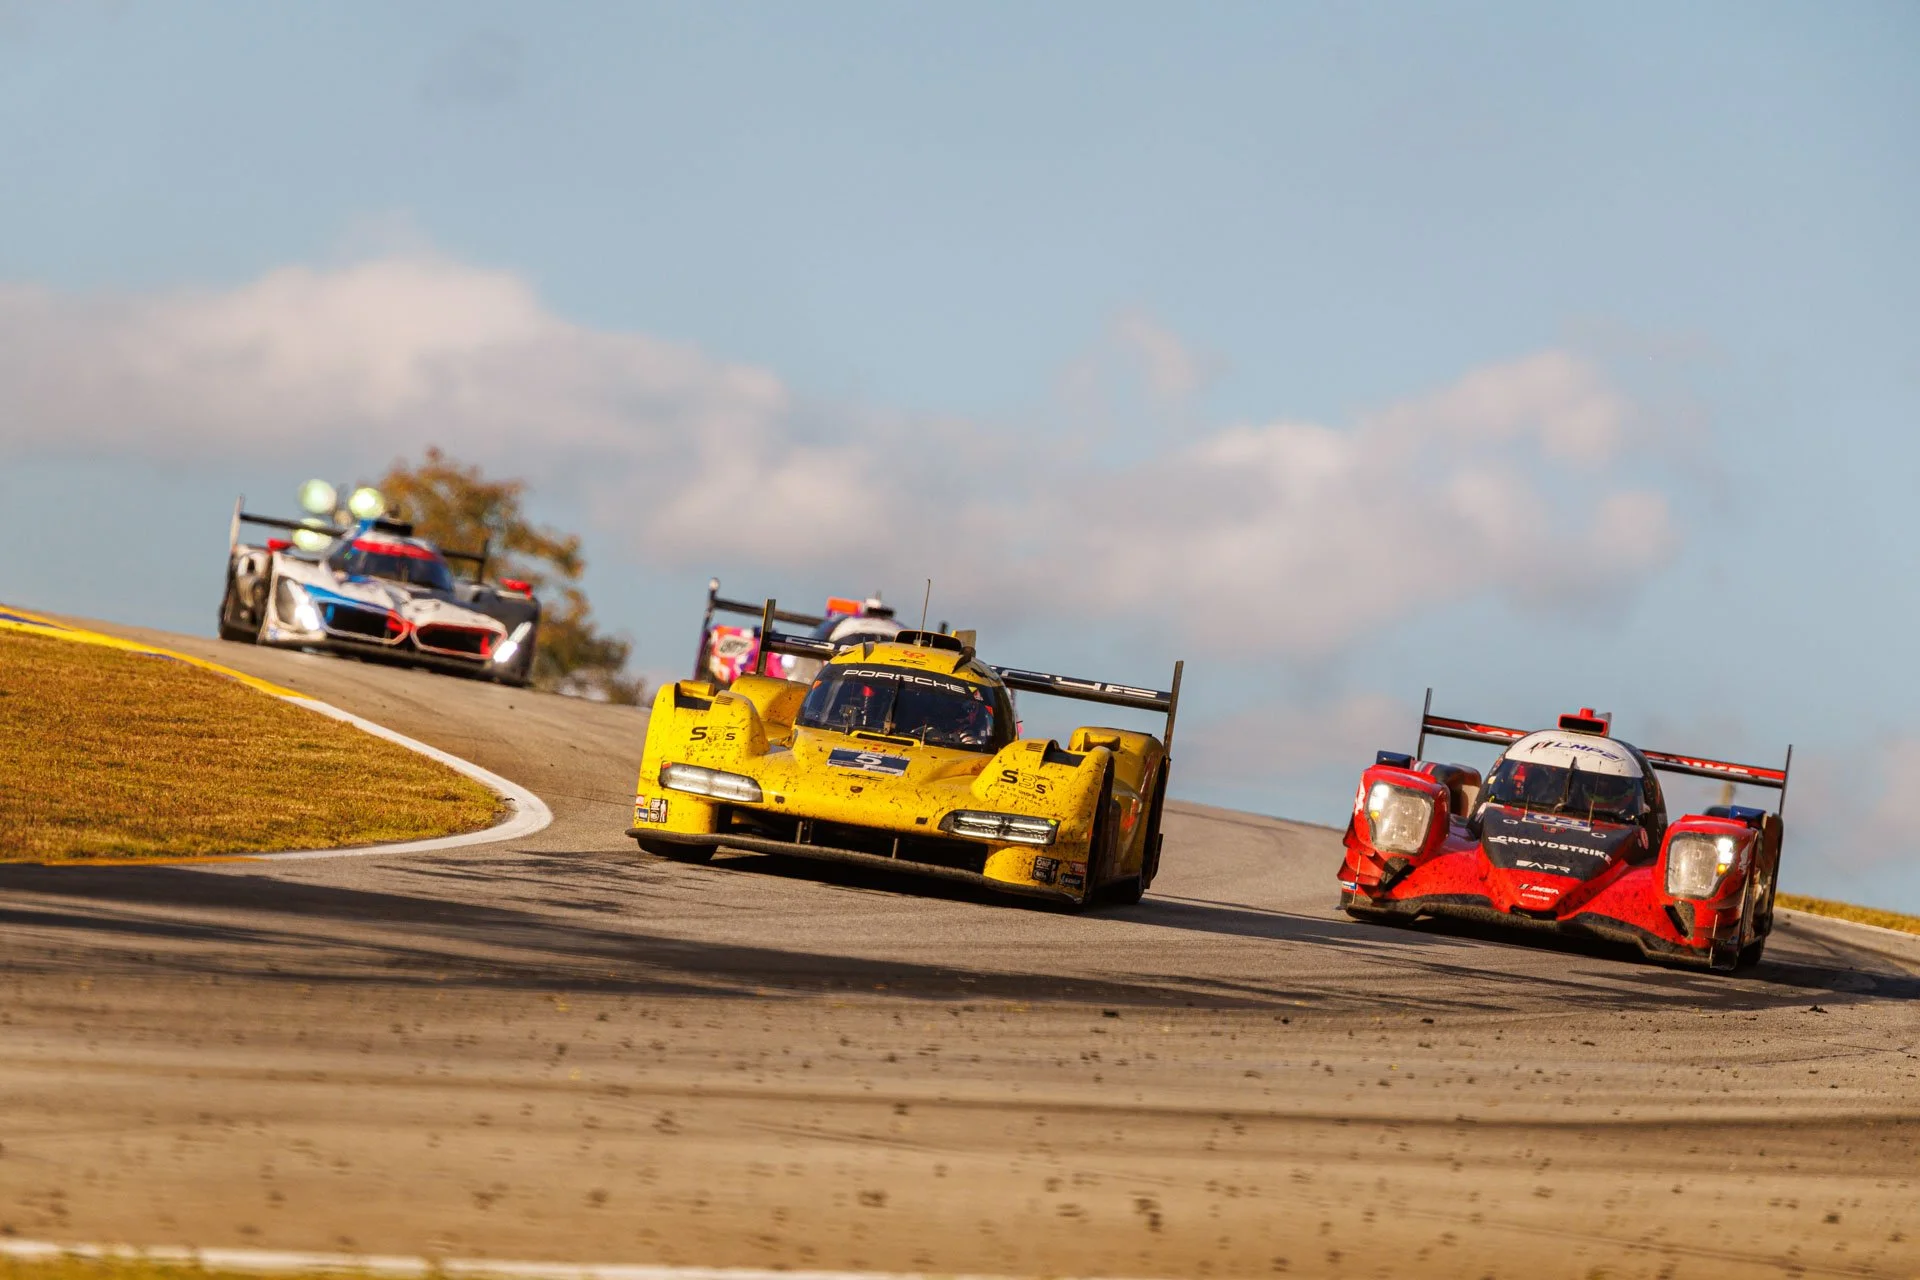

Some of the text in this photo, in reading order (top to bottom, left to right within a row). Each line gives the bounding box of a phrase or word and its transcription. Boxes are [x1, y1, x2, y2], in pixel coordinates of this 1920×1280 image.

[842, 669, 966, 694] PORSCHE
[855, 753, 882, 765] 5
[1495, 836, 1612, 866] CROWDSTRIKE
